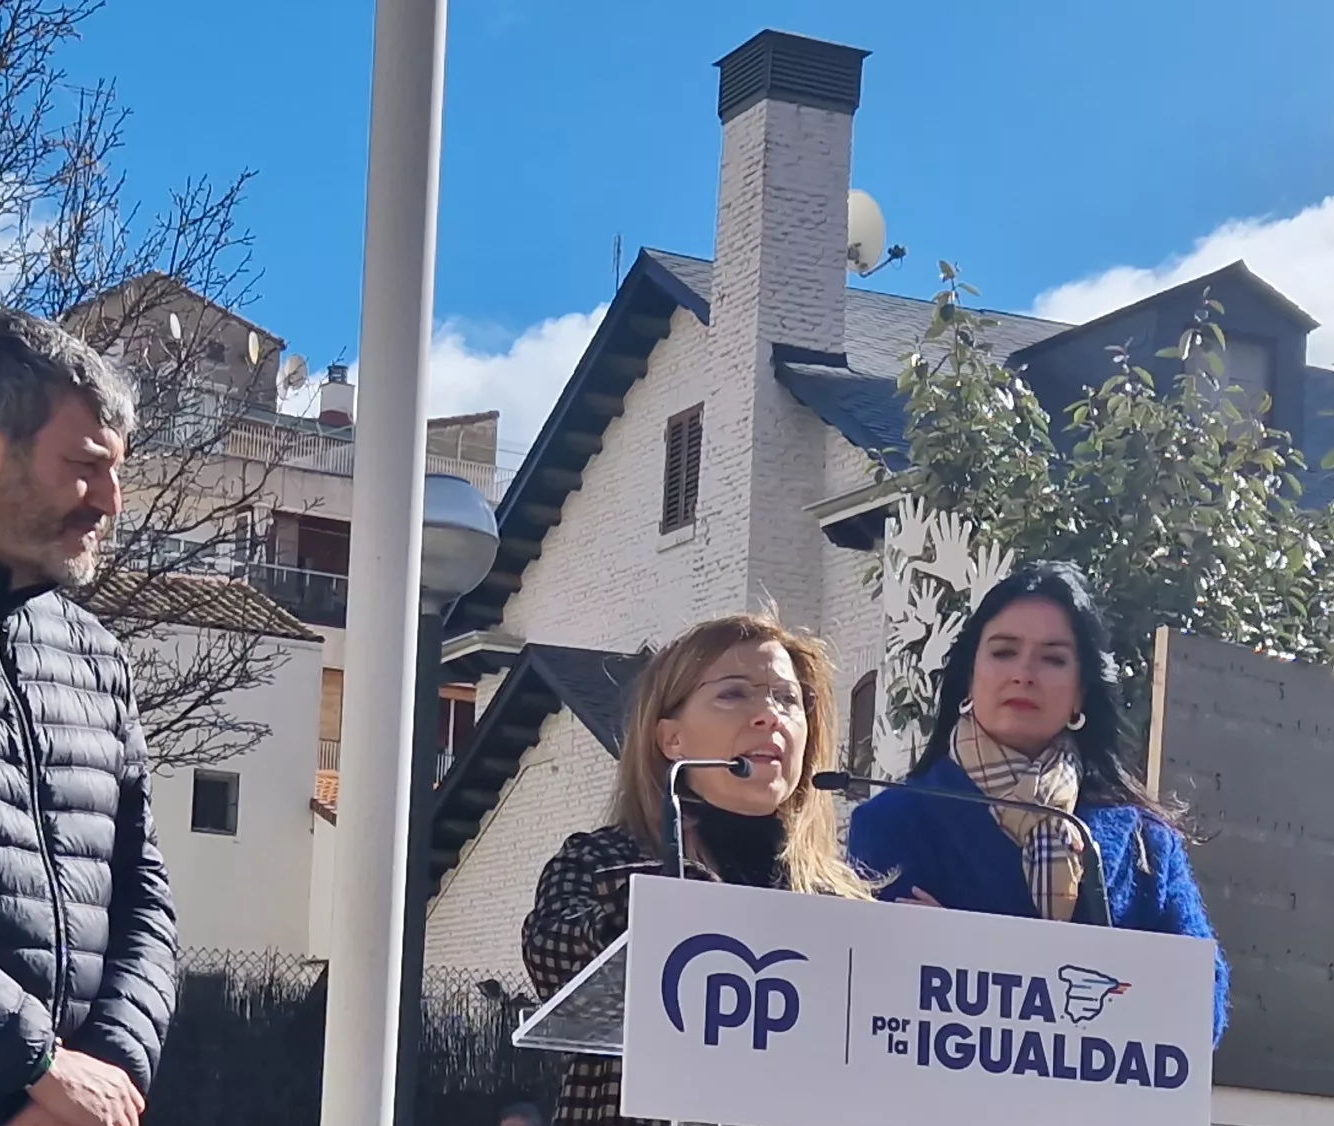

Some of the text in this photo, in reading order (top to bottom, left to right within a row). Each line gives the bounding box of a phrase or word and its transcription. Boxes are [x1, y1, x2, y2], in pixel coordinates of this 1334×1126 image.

[918, 964, 1056, 1024] RUTA
[871, 1015, 912, 1036] por
[887, 1031, 909, 1055] la
[916, 1019, 1189, 1090] IGUALDAD
